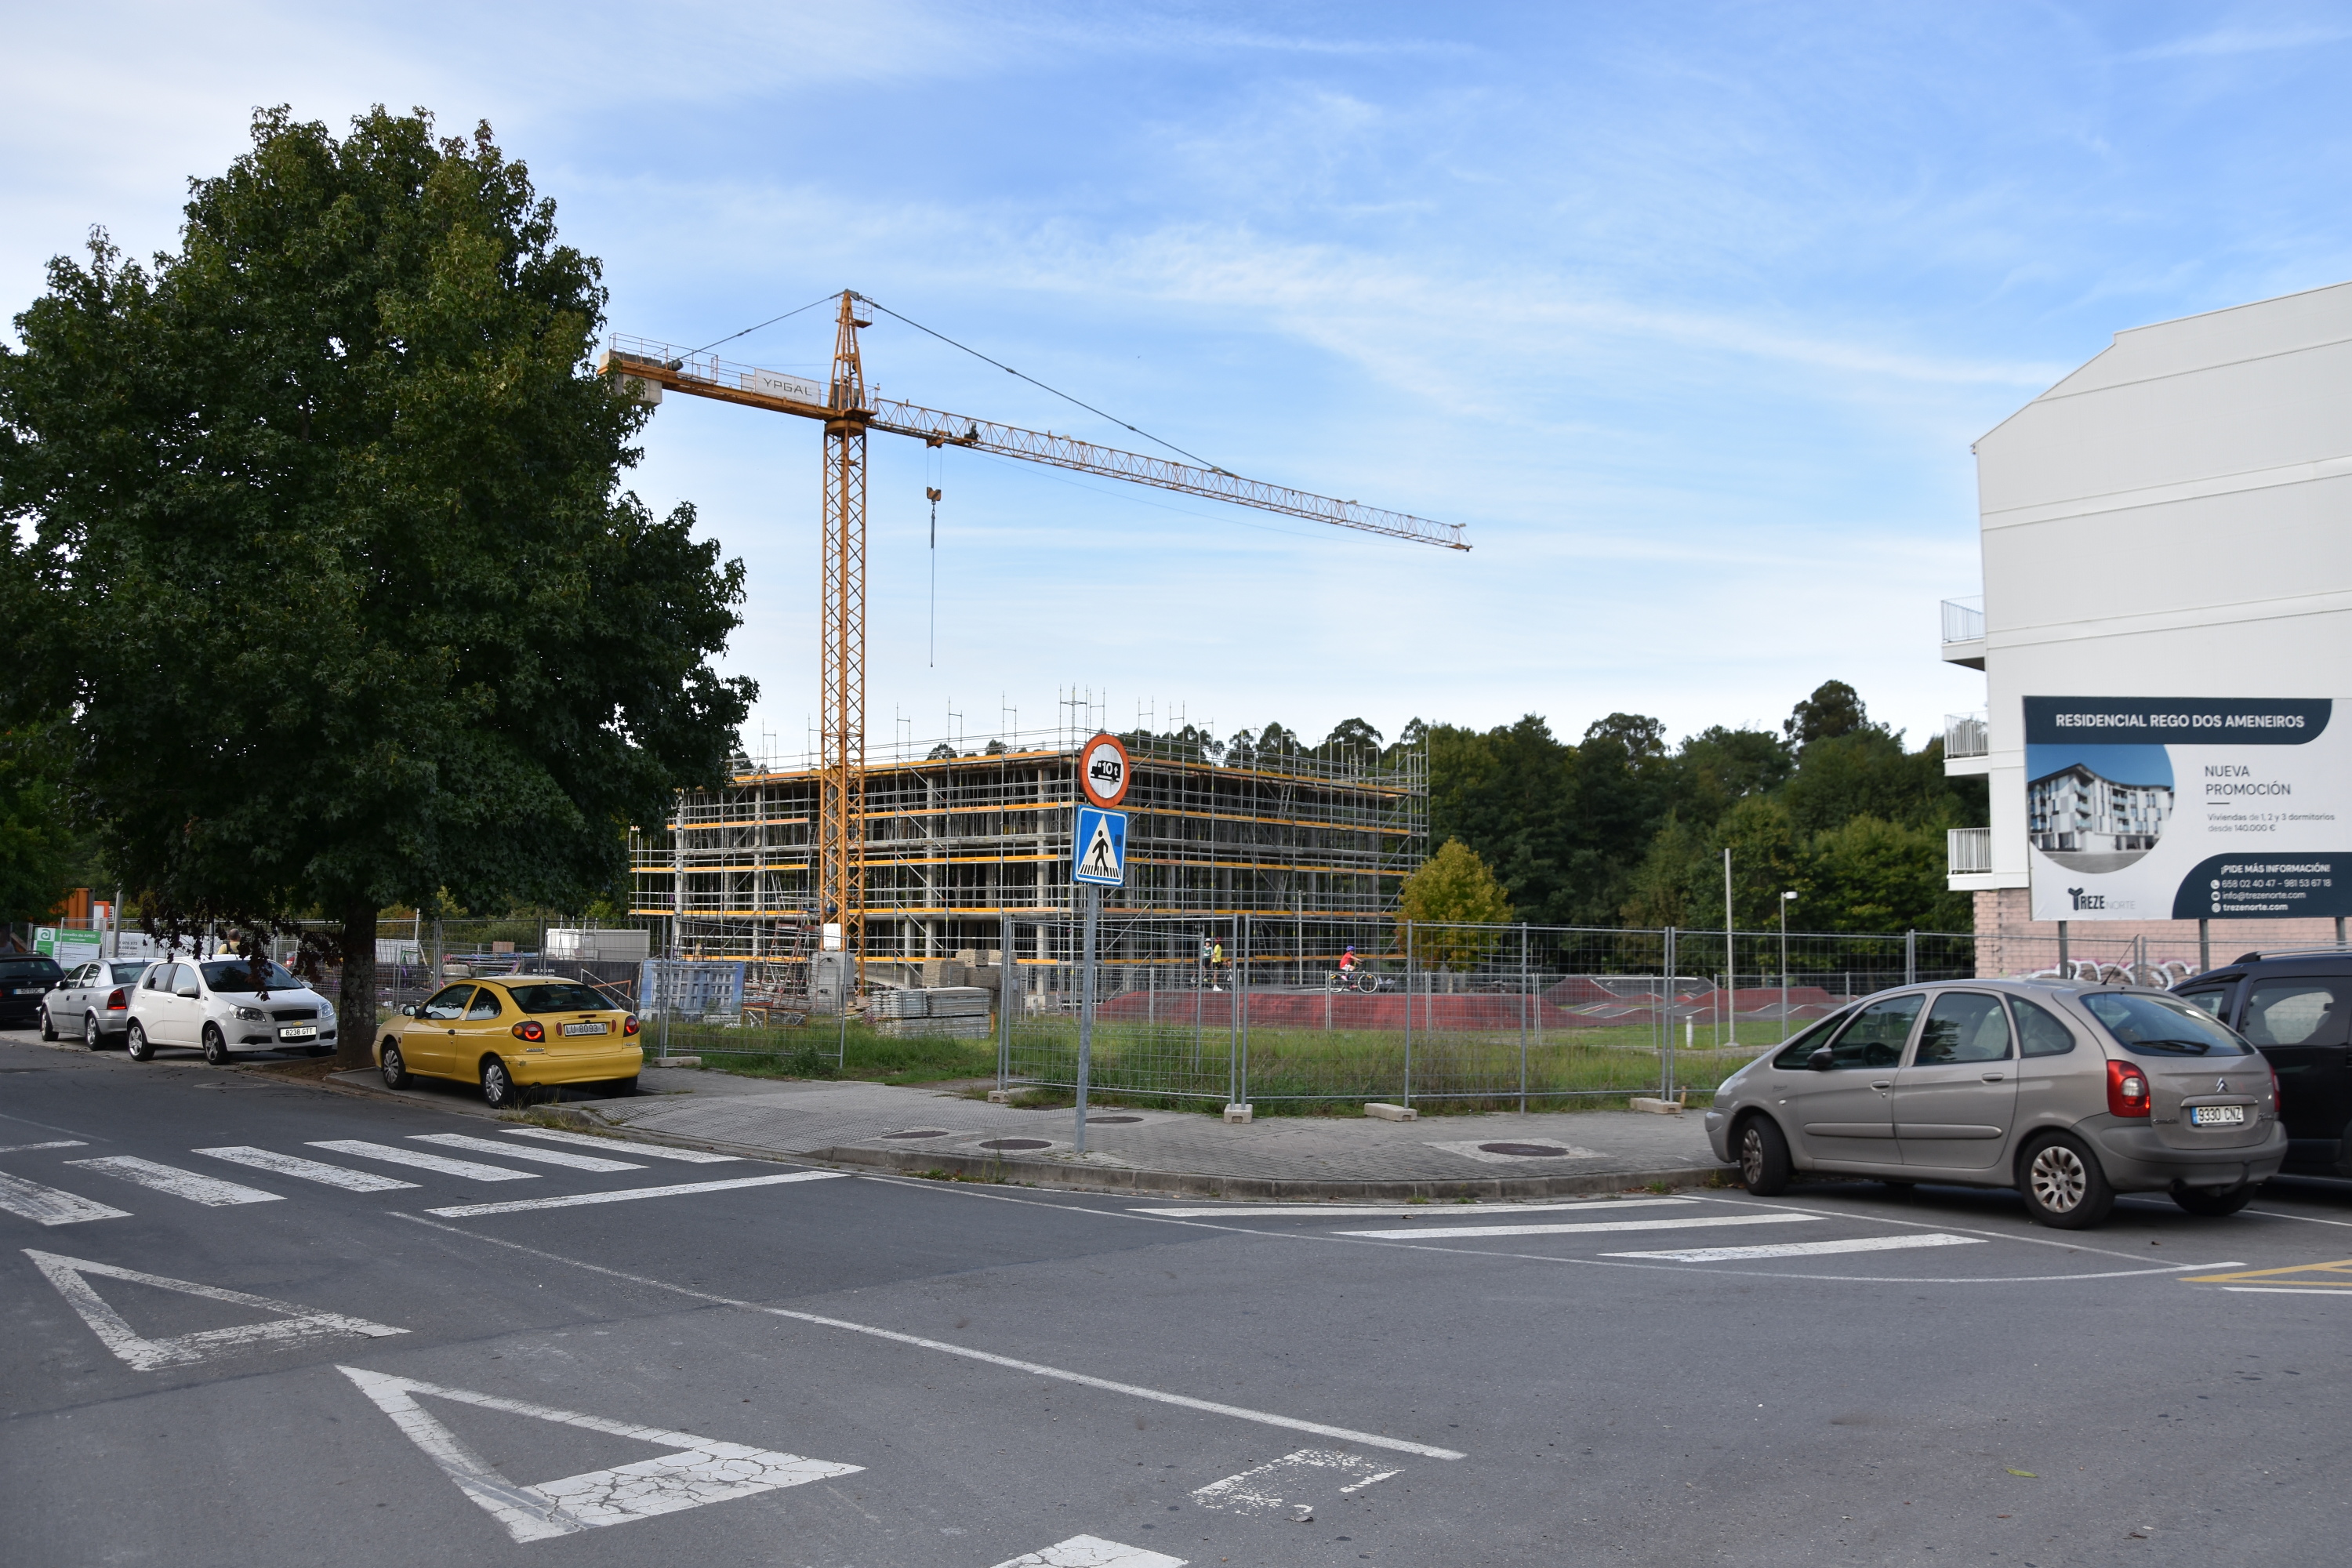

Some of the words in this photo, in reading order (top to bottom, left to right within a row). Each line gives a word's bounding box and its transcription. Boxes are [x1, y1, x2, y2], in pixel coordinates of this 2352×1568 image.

[764, 378, 812, 396] YPGAL
[2056, 714, 2147, 727] RESIDENCIAL
[2151, 714, 2190, 727] REGO
[2192, 715, 2222, 728] DOS
[2225, 715, 2305, 728] AMENEIROS
[1102, 762, 1112, 775] 10
[1114, 766, 1118, 775] t
[2205, 765, 2250, 777] NUEVA
[2205, 781, 2291, 795] PROMOCIÓN
[2220, 865, 2243, 875] ¡PIDE
[2245, 863, 2264, 873] MÁS
[2266, 862, 2331, 873] INFORMACIÓN!
[2222, 891, 2307, 901] info@trezenorte.com
[2198, 1108, 2220, 1121] 9330
[2224, 1107, 2241, 1120] CNZ
